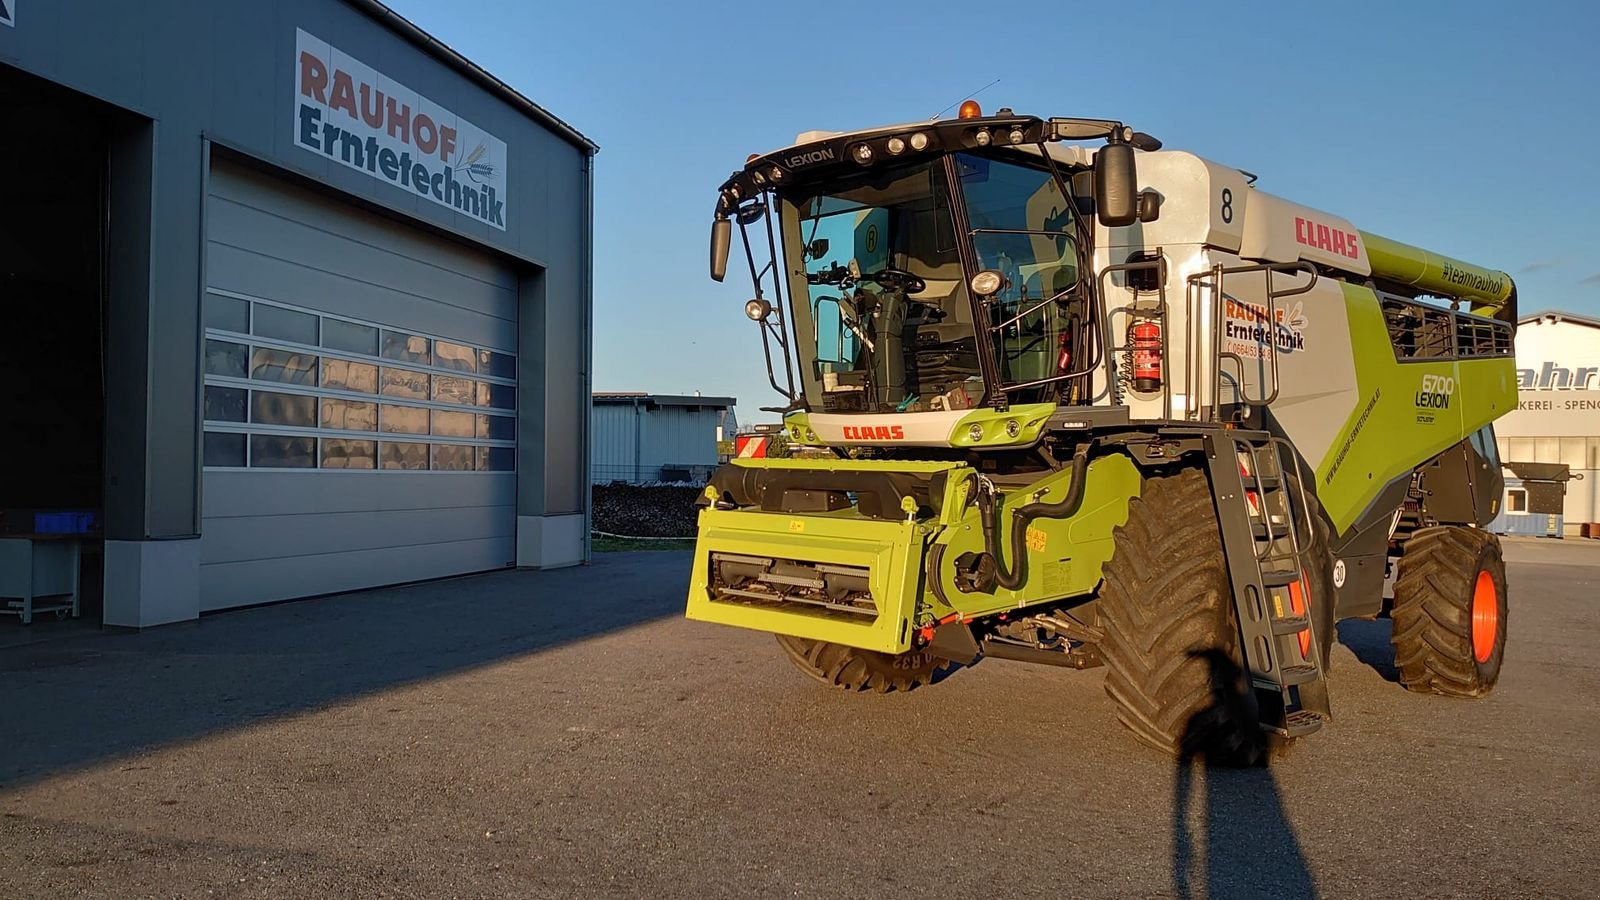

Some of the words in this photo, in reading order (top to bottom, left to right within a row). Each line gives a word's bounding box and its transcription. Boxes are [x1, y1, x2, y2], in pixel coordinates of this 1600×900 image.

[299, 51, 457, 162] RAUHOF
[299, 103, 503, 226] Erntetechnik
[785, 148, 834, 168] LEXION
[1221, 188, 1233, 224] 8
[1295, 217, 1358, 259] CLAAS
[1441, 262, 1504, 295] #teamrauhof
[1423, 374, 1454, 395] 6700
[1517, 362, 1600, 388] ahr
[1415, 392, 1449, 409] LEXION
[843, 425, 904, 440] CLAAS
[1335, 565, 1343, 582] 30
